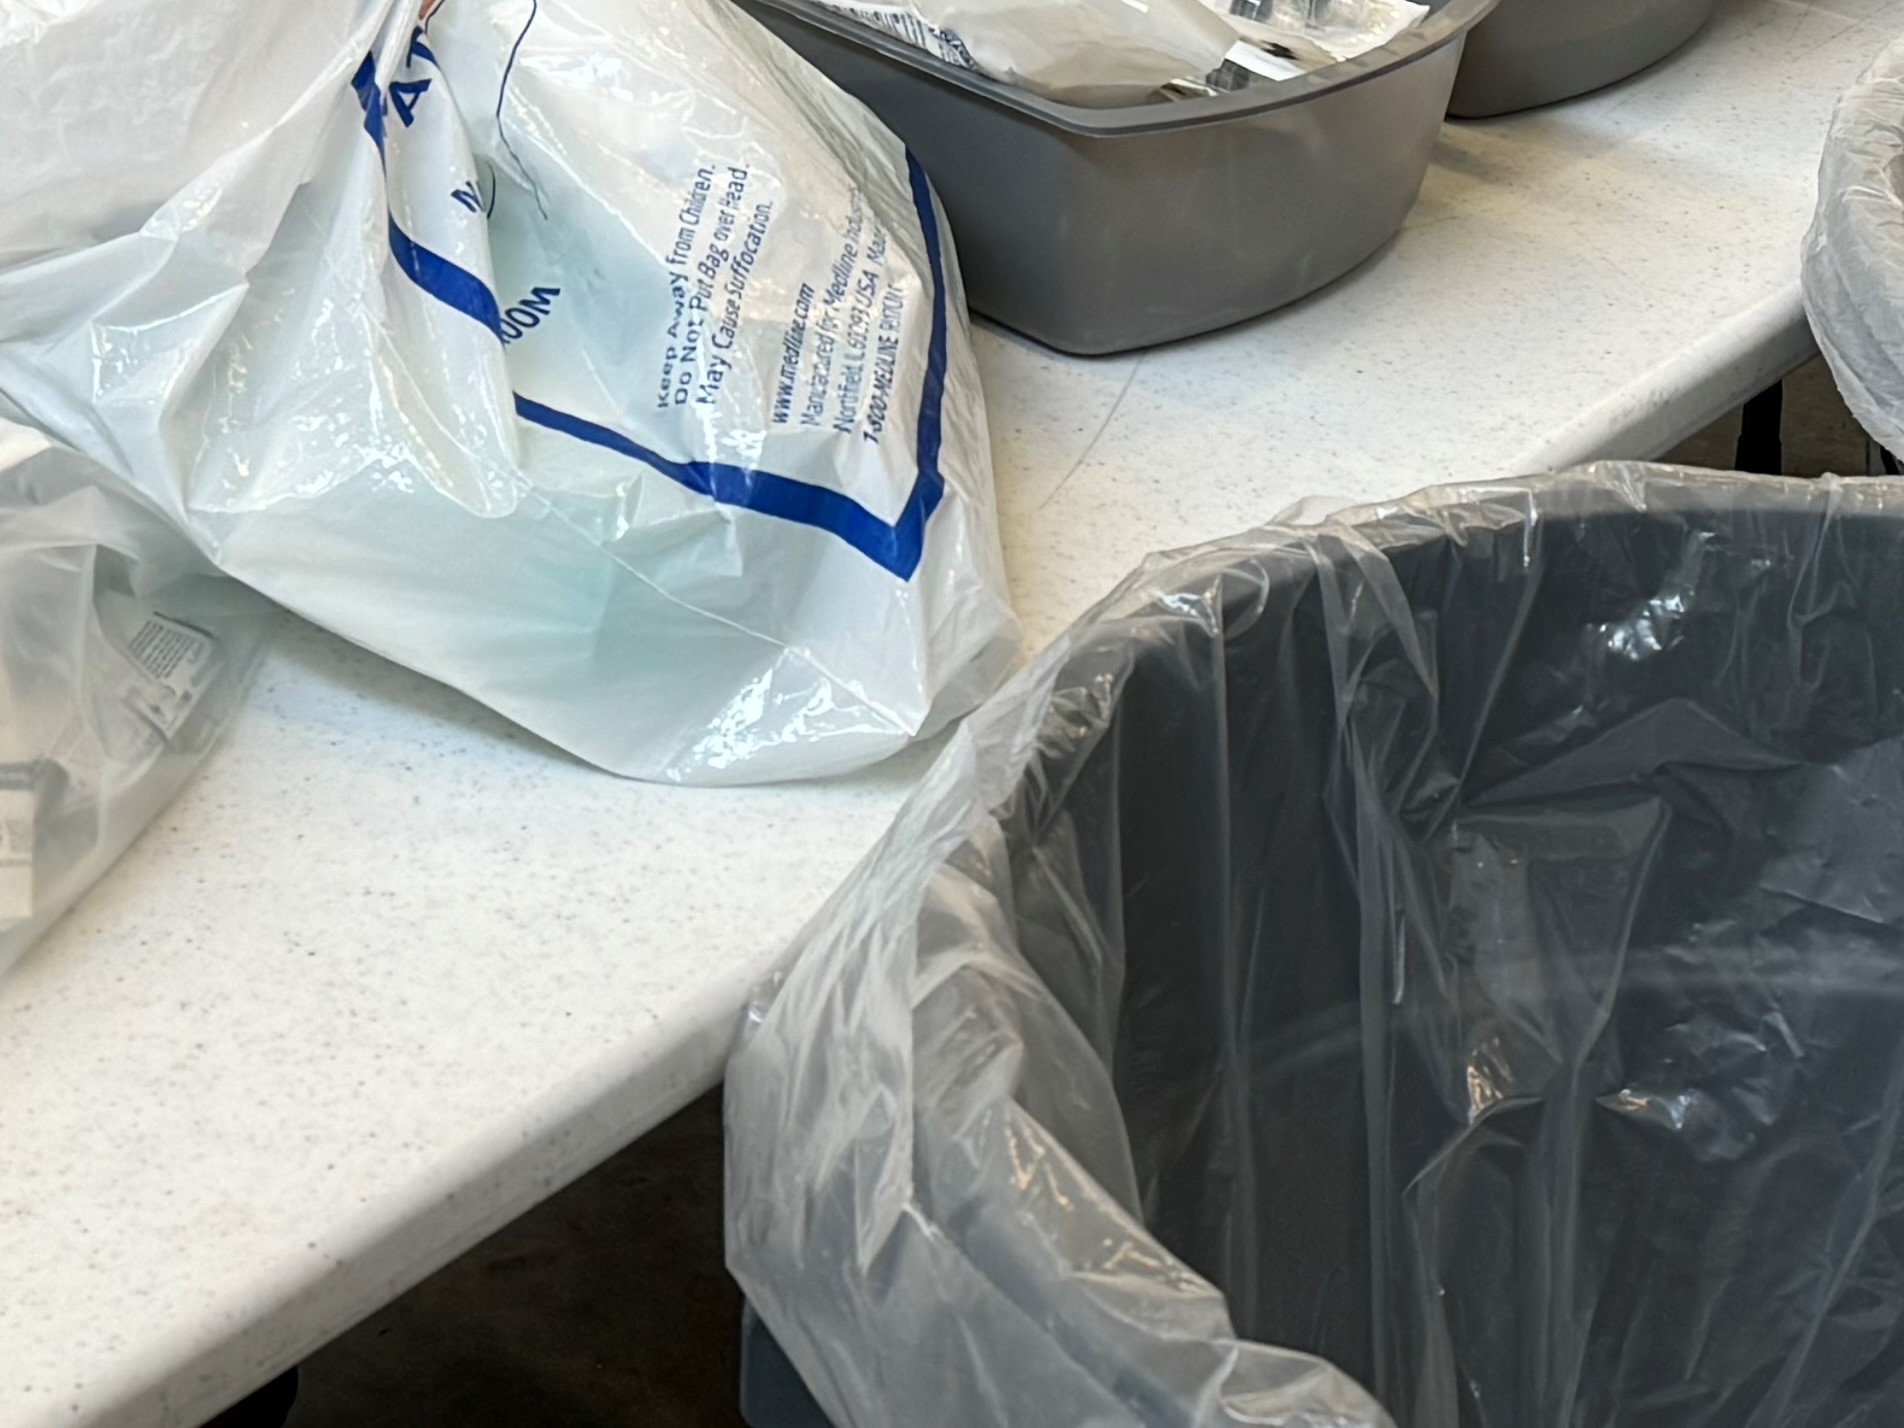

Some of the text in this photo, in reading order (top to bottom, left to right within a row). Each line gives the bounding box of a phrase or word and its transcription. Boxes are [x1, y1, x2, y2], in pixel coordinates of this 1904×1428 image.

[665, 227, 696, 267] from
[713, 207, 737, 243] over
[696, 241, 731, 280] Bag
[822, 242, 860, 310] Medline
[666, 271, 689, 339] Away
[689, 279, 715, 314] Put
[696, 199, 774, 406] May Cause Suffocation.
[855, 268, 881, 310] USA
[680, 318, 706, 364] Not
[771, 282, 816, 425] www.medline.com
[657, 345, 679, 409] Keep
[674, 370, 694, 406] Do
[862, 333, 900, 445] 1-800-MEDLINE
